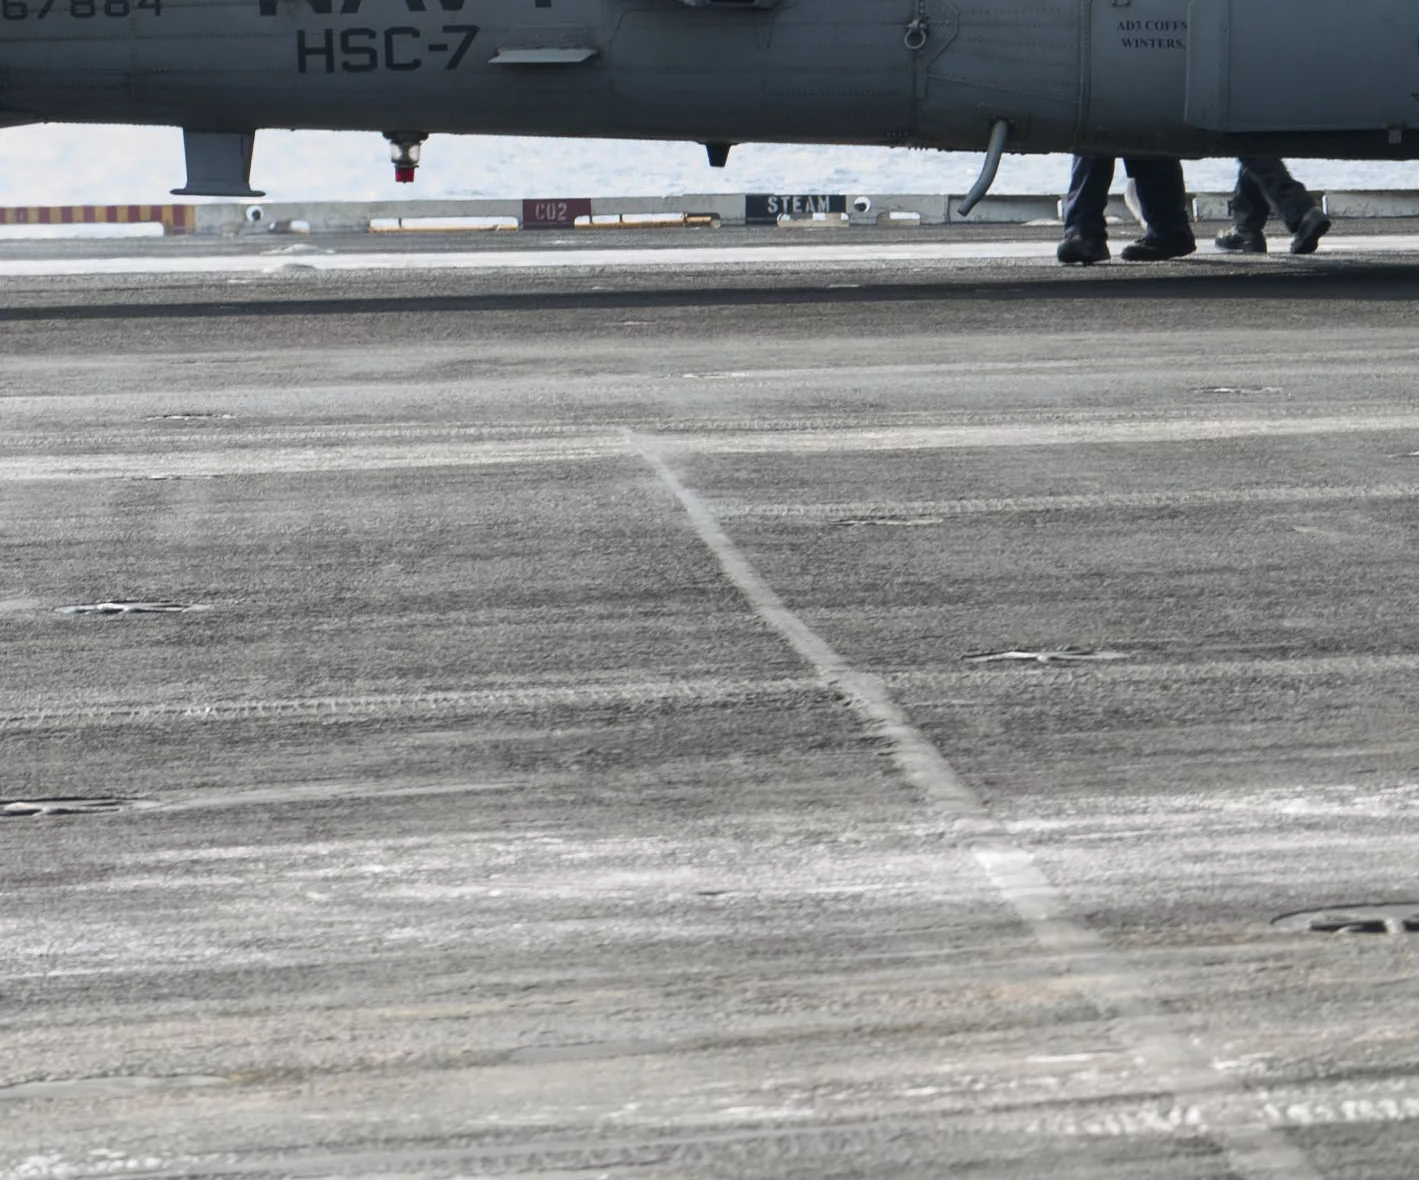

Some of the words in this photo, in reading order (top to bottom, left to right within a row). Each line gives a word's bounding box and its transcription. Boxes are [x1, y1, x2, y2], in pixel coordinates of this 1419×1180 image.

[297, 24, 480, 74] HSC-7
[535, 203, 568, 221] CO2
[767, 195, 830, 213] STEAM
